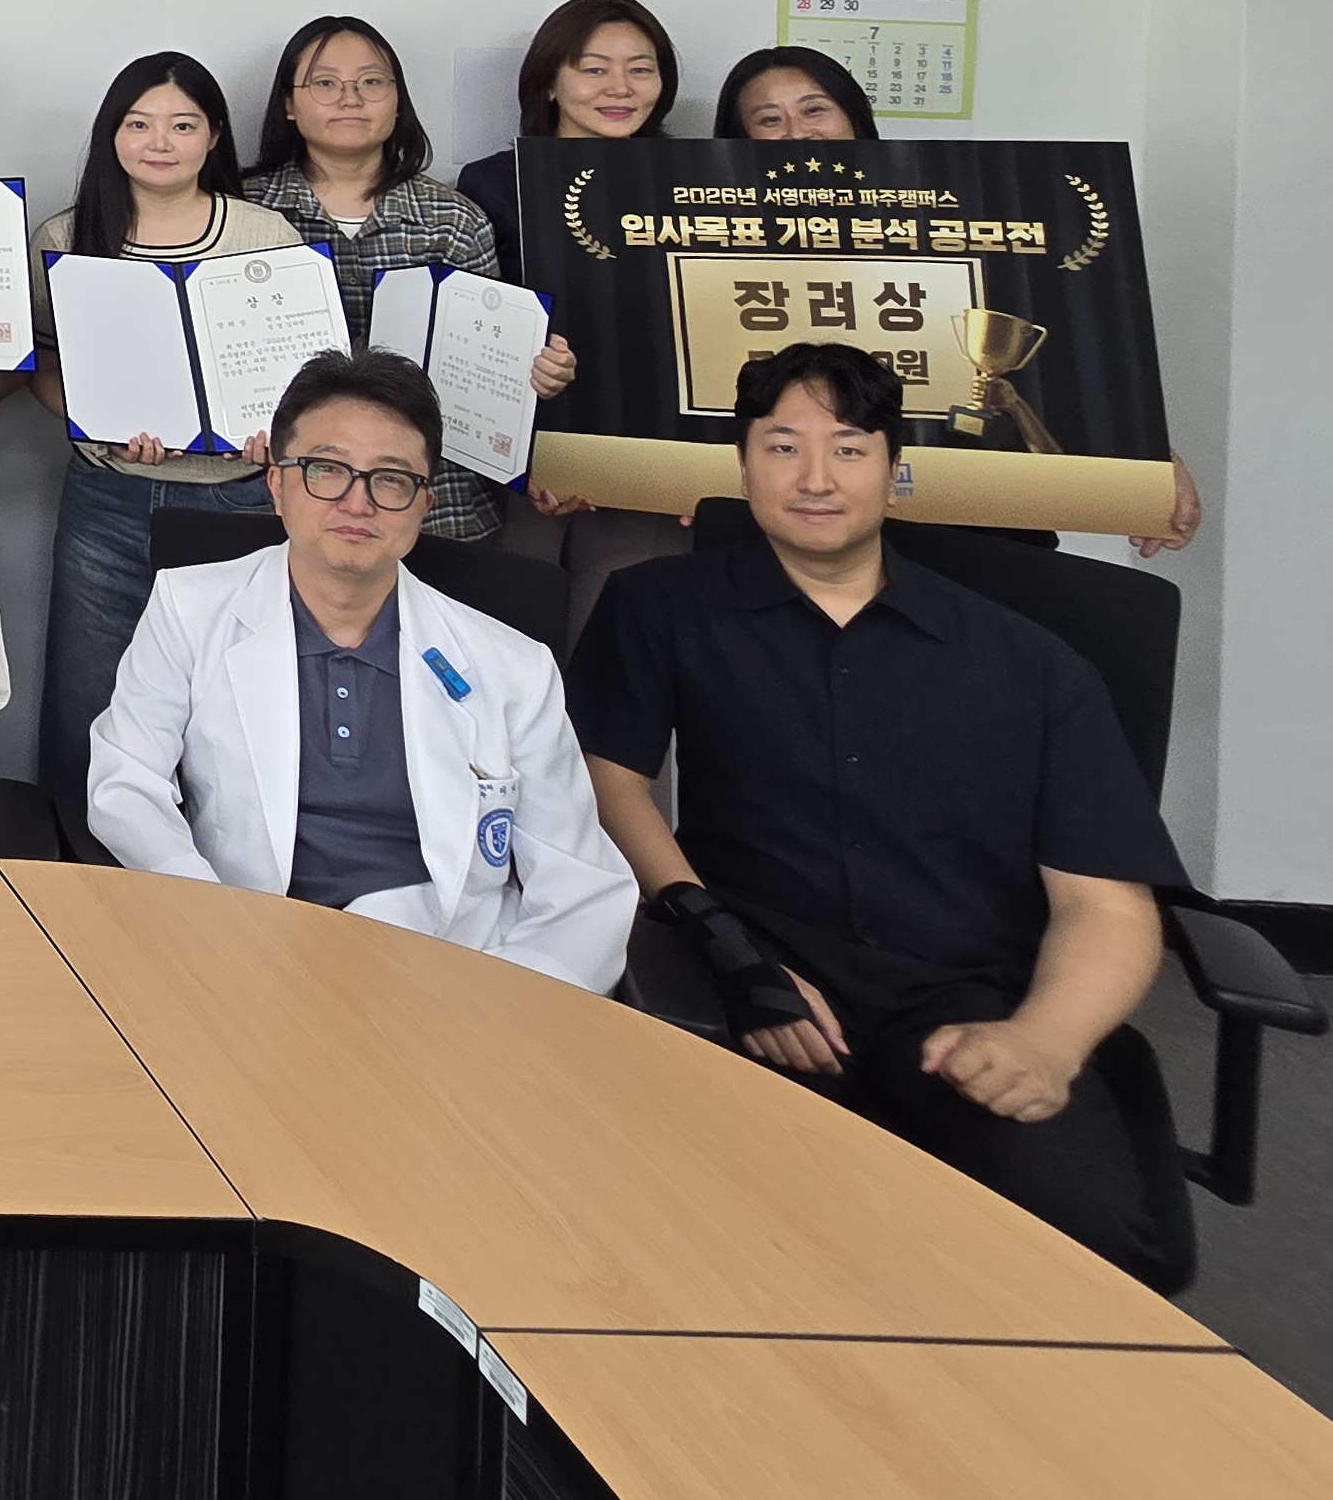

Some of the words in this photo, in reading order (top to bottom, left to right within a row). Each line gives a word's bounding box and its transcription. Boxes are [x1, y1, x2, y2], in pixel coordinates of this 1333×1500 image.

[820, 0, 835, 10] 29
[843, 0, 859, 11] 30
[870, 26, 880, 39] 7
[673, 187, 758, 205] 2026년
[763, 188, 856, 208] 서영대학교
[858, 188, 959, 208] 파주캠퍼스
[620, 214, 767, 248] 입사목표
[776, 217, 841, 249] 기업
[850, 218, 918, 251] 분석
[928, 219, 1047, 254] 공모전
